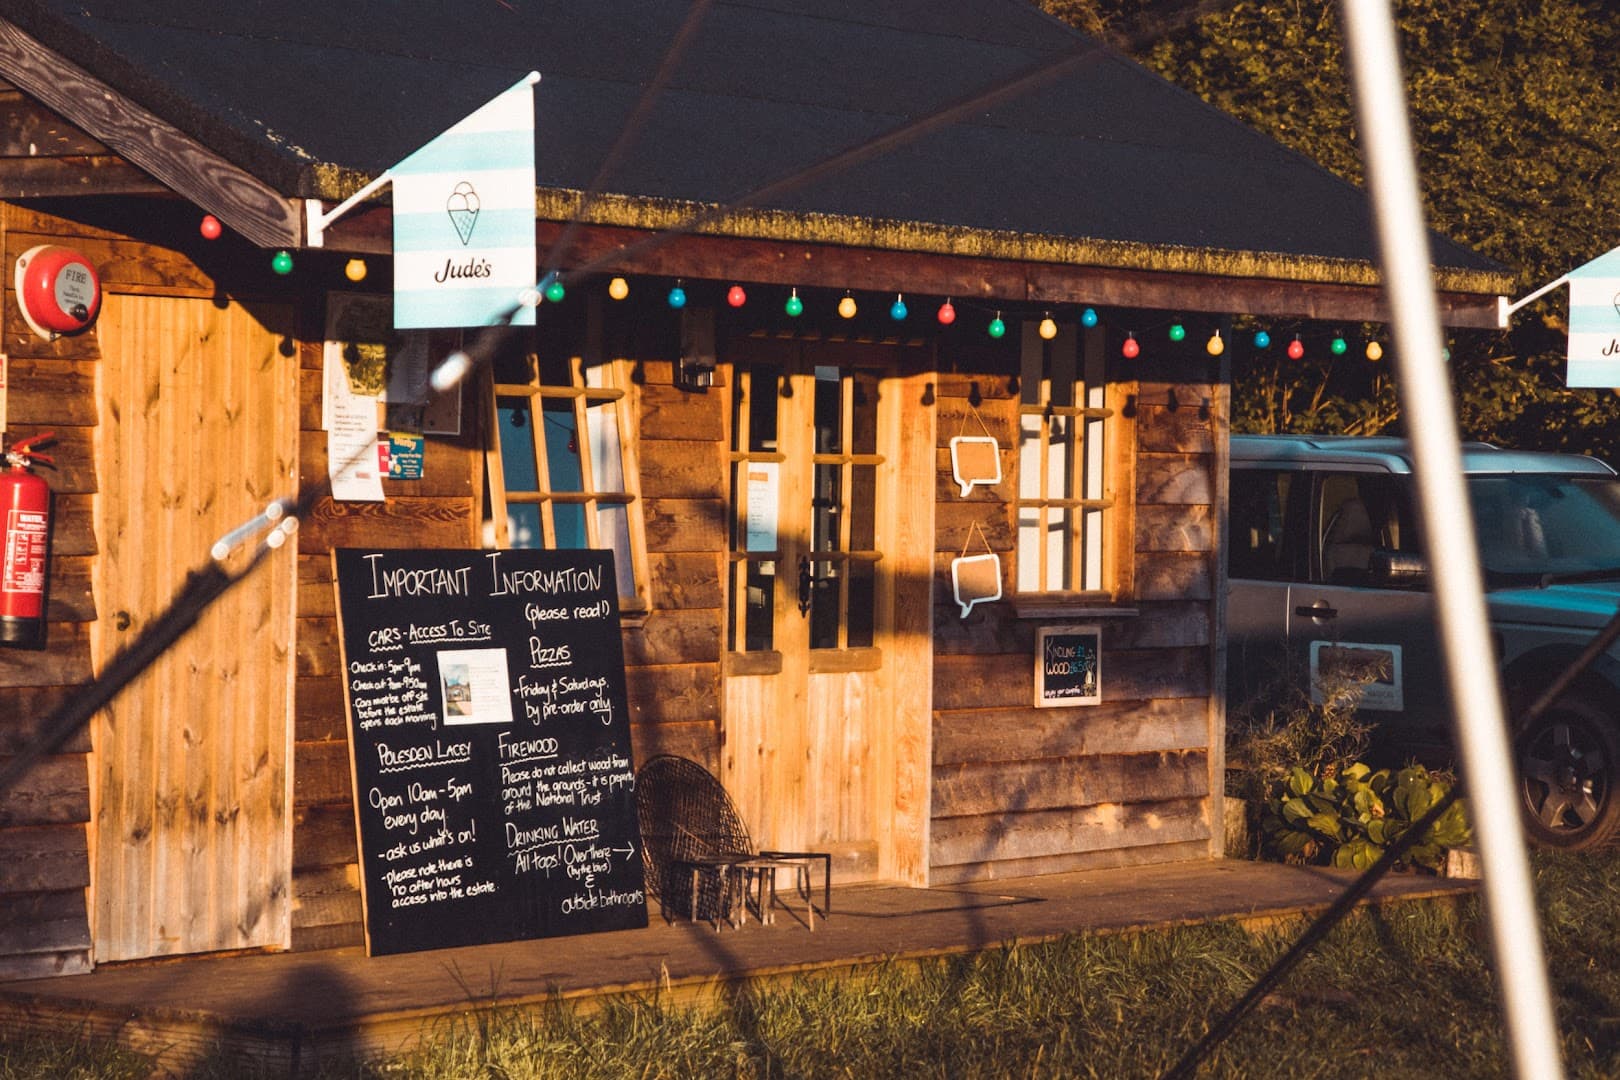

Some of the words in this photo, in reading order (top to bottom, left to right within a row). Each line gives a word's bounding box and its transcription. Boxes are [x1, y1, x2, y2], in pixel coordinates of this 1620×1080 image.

[65, 269, 87, 284] FIRE
[434, 257, 492, 283] Jude's
[362, 553, 472, 599] IMPORTANT
[485, 551, 602, 596] INFORMATION
[525, 602, 569, 630] (please
[573, 600, 610, 620] read!)
[368, 628, 401, 647] CARS
[409, 623, 447, 642] ACCESS
[468, 620, 491, 636] SITE
[529, 636, 571, 664] PIZZAS
[1046, 662, 1070, 676] WOOD
[526, 701, 540, 726] by
[377, 743, 433, 767] POLESDEN
[436, 739, 472, 759] LACEY
[498, 731, 558, 759] FIREWOOD
[502, 766, 531, 784] Please
[532, 767, 542, 778] do
[543, 766, 556, 777] not
[557, 760, 586, 775] collect
[588, 756, 611, 771] wood
[611, 753, 629, 769] from
[369, 787, 404, 816] Open
[502, 782, 532, 800] around
[536, 780, 550, 793] the
[504, 801, 516, 816] of
[516, 799, 533, 812] the
[535, 791, 575, 807] National
[384, 813, 418, 835] every
[409, 842, 421, 854] us
[422, 828, 454, 850] what's
[458, 818, 476, 843] on!
[505, 822, 558, 849] DRINKING
[562, 817, 599, 837] WATER
[418, 862, 438, 877] note
[438, 858, 463, 873] there
[464, 855, 473, 867] is
[515, 852, 530, 874] All
[531, 845, 561, 878] taps!
[391, 885, 407, 897] no
[408, 879, 434, 894] after
[435, 875, 461, 888] hours
[391, 893, 428, 909] access
[429, 888, 448, 902] into
[449, 886, 465, 900] the
[561, 889, 599, 914] outside
[598, 888, 645, 909] bathrooms
